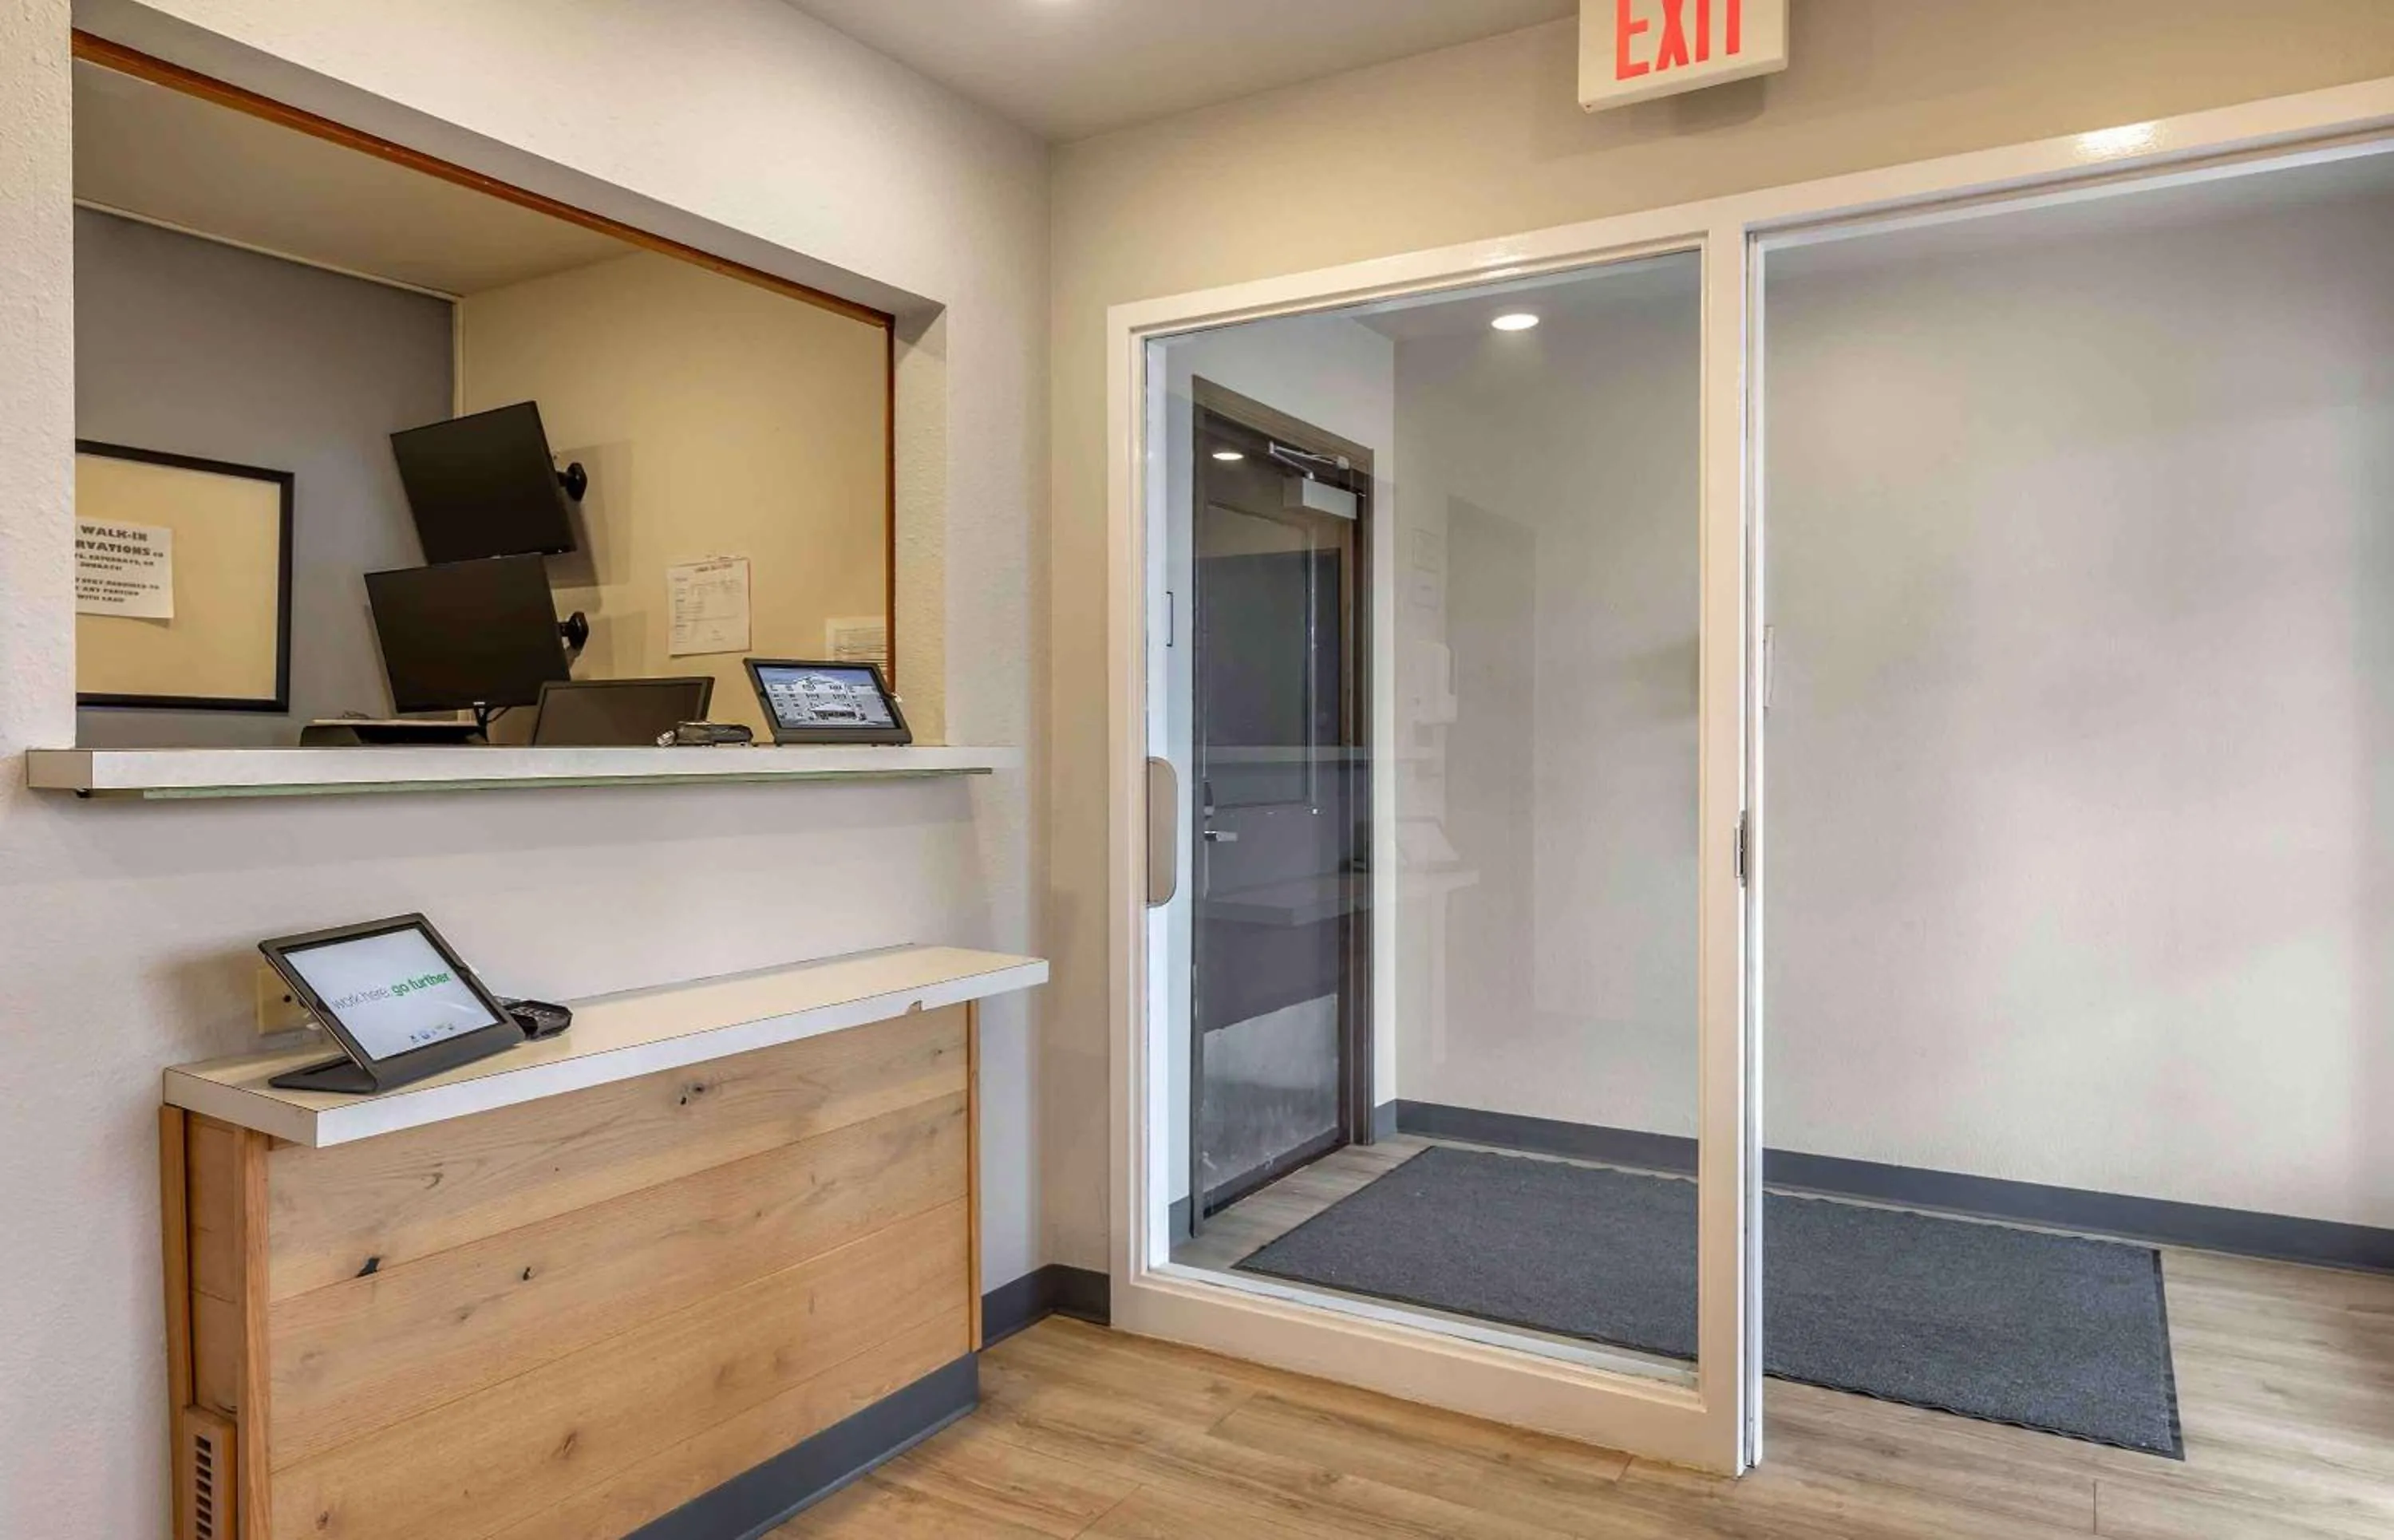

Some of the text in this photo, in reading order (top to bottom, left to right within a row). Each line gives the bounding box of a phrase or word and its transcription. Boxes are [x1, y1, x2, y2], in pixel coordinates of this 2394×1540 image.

[81, 525, 148, 542] WALK-IN
[391, 984, 409, 997] go
[408, 973, 451, 990] further
